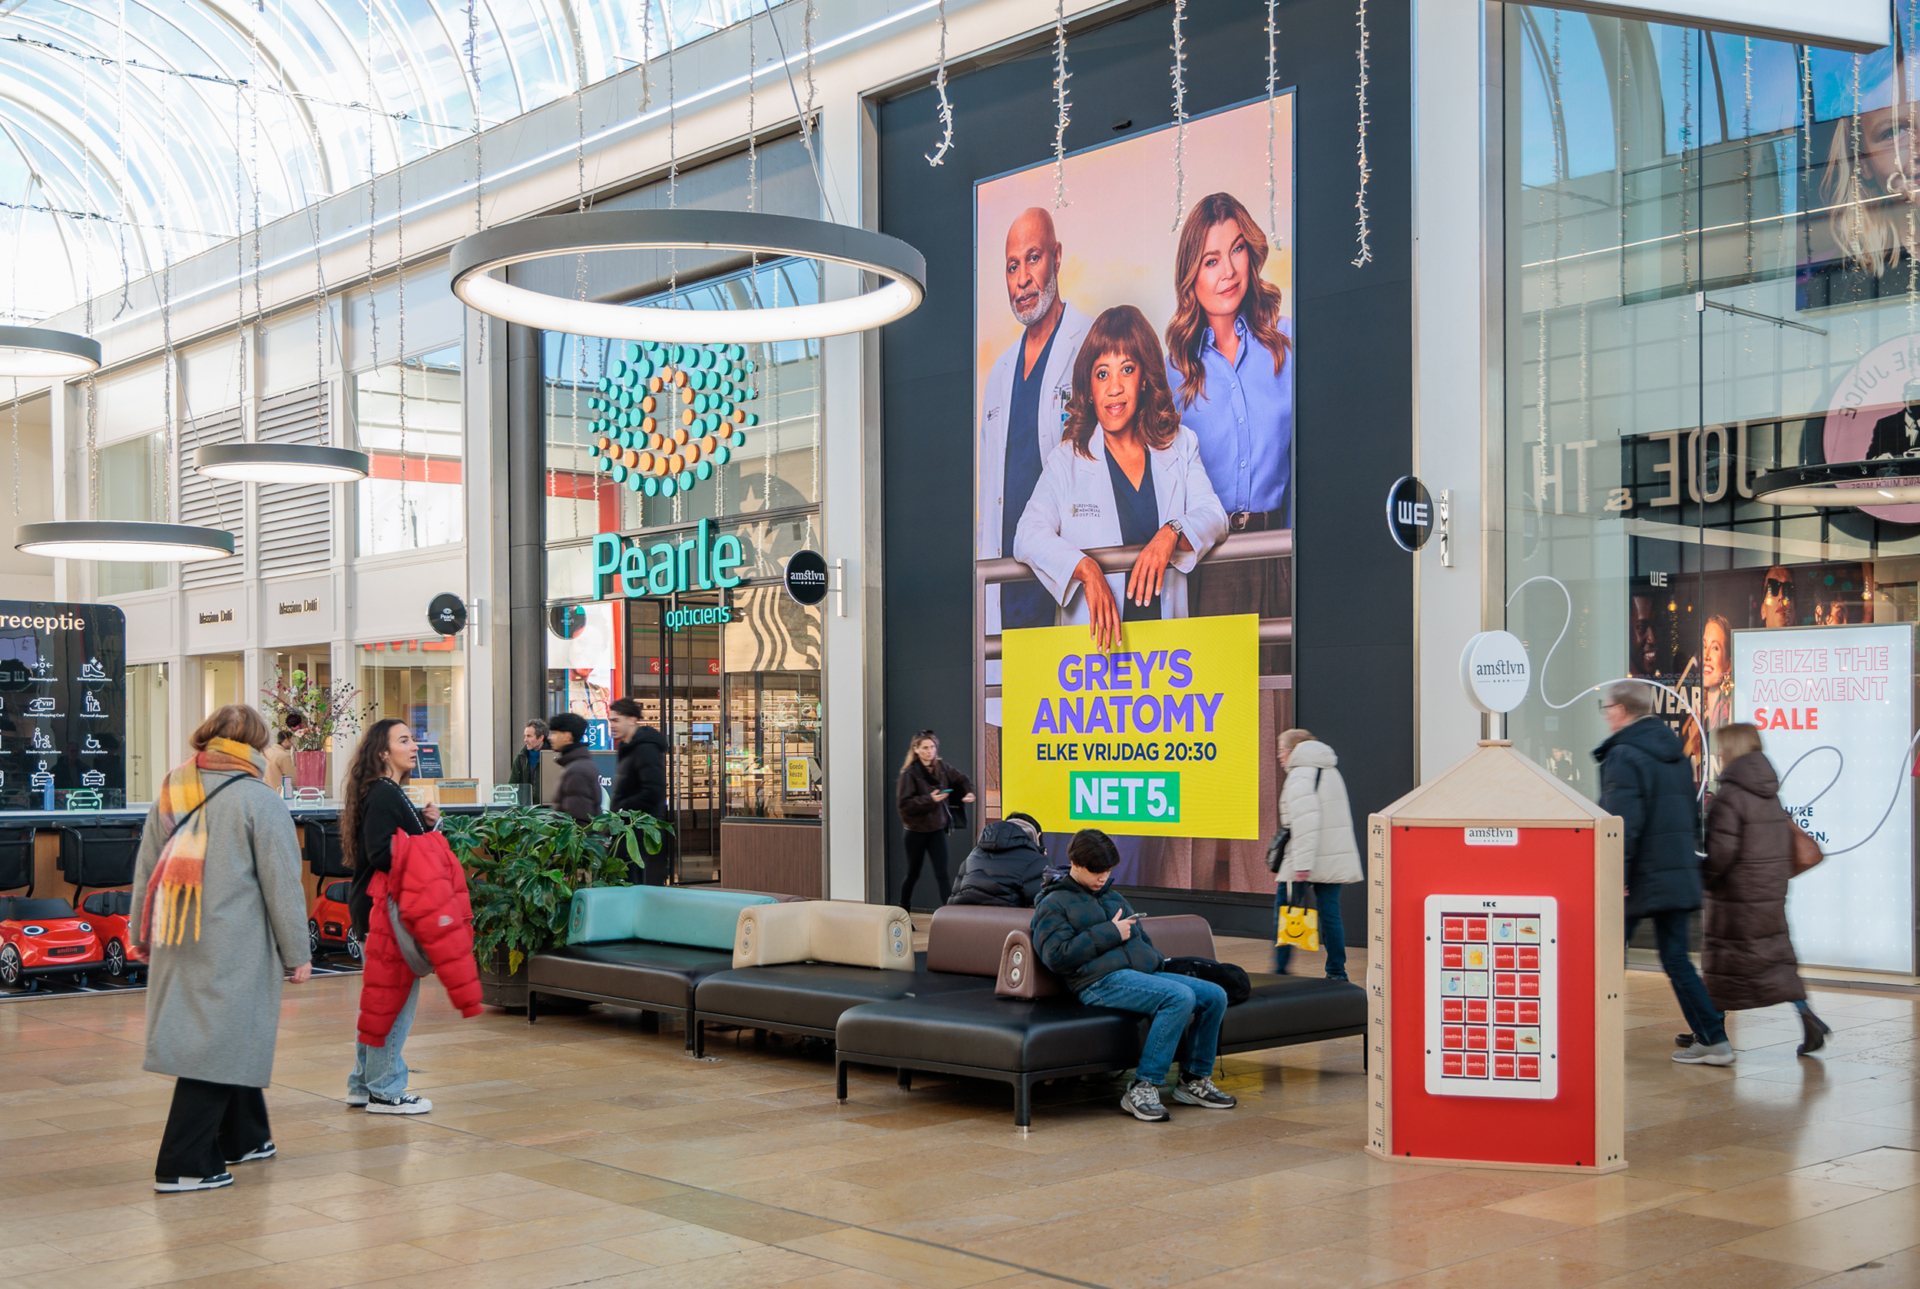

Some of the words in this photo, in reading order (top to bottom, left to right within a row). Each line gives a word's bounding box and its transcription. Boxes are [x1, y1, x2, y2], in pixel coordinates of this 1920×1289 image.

[1398, 501, 1428, 526] WE
[593, 518, 743, 600] Pearle
[790, 569, 826, 581] amstlvn
[1650, 571, 1668, 587] WE
[0, 612, 85, 635] receptie
[666, 606, 732, 632] opticiens
[1058, 649, 1193, 692] GREY'S
[1476, 660, 1526, 676] amstlvn
[1752, 648, 1828, 674] SEIZE
[1834, 646, 1889, 671] THE
[1752, 676, 1888, 703] MOMENT
[1032, 693, 1224, 735] ANATOMY
[1753, 707, 1819, 730] SALE
[588, 723, 597, 747] voor
[1037, 742, 1078, 761] ELKE
[1083, 742, 1159, 762] VRIJDAG
[1164, 742, 1217, 761] 20:30
[1469, 827, 1513, 838] amstlvn
